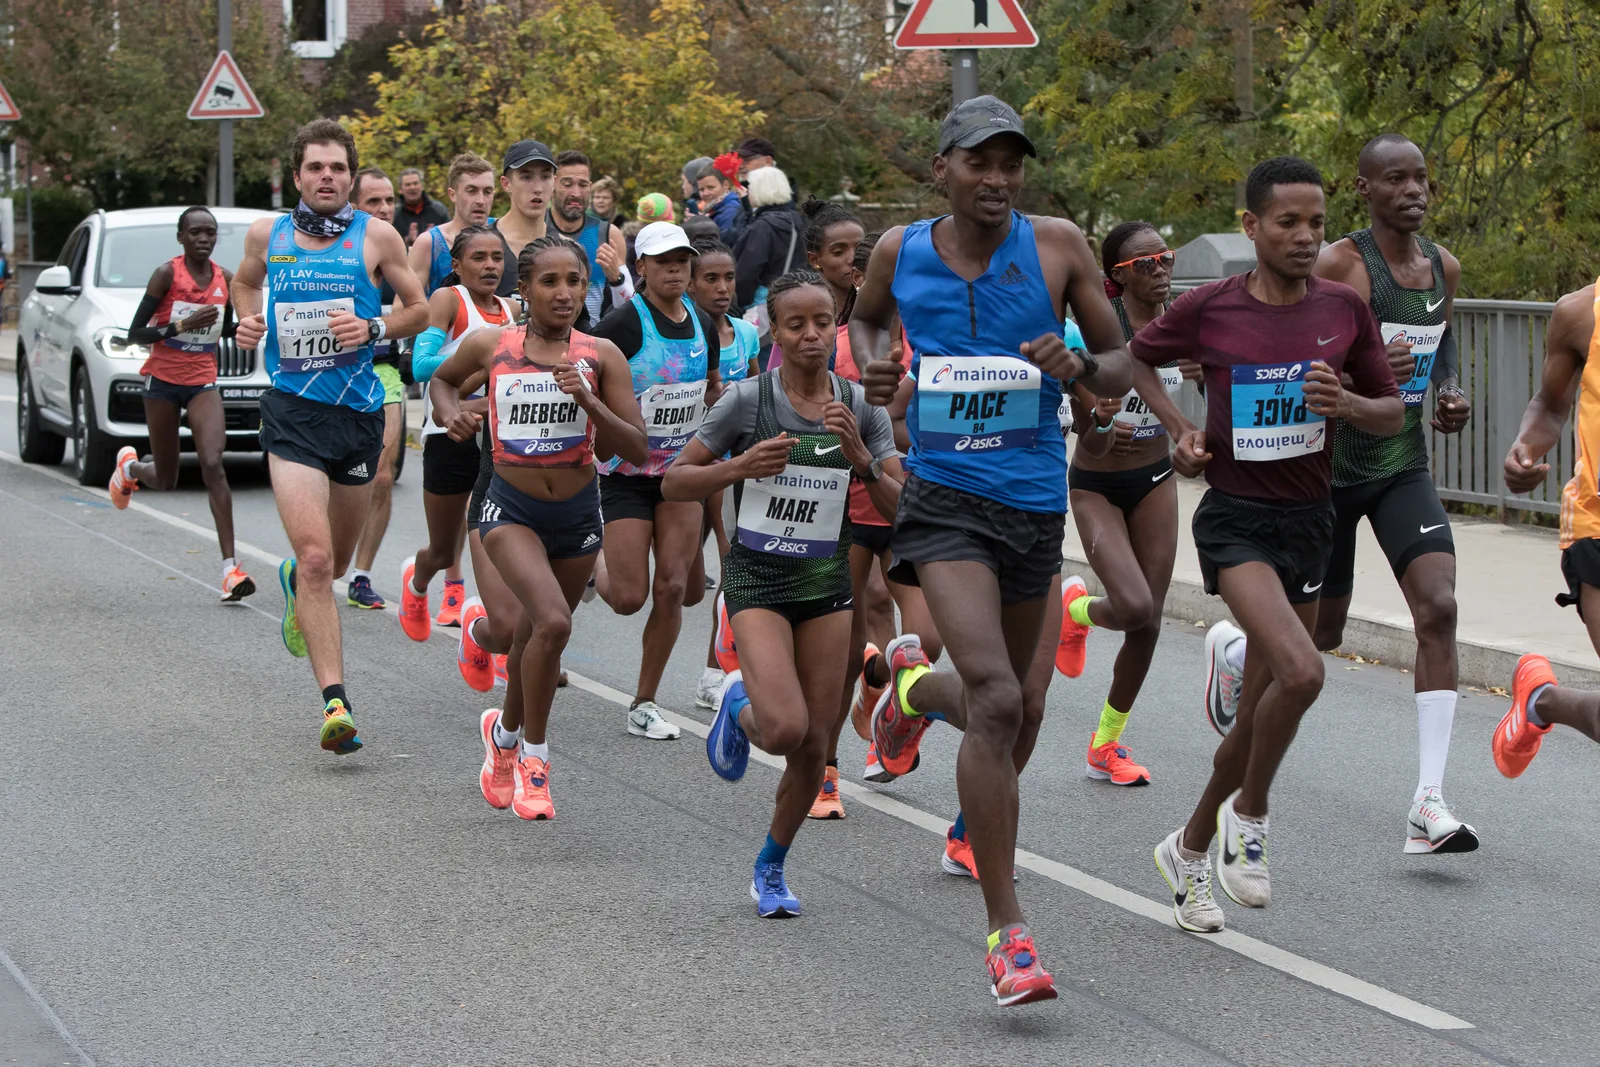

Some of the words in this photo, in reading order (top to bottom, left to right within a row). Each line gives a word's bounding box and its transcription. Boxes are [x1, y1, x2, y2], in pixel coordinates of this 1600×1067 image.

[290, 269, 313, 279] LAV
[314, 271, 355, 281] Stadtwerke
[290, 280, 355, 293] TÜBINGEN
[301, 328, 330, 337] Lorenz
[292, 336, 344, 357] 1106
[312, 359, 335, 369] asics
[954, 367, 1029, 381] mainova
[1255, 367, 1287, 380] asics
[223, 389, 242, 398] DER
[664, 387, 702, 401] mainova
[1274, 383, 1286, 396] 72
[1404, 392, 1423, 403] asics
[949, 391, 1009, 420] PACE
[1252, 395, 1307, 427] PACE
[508, 402, 579, 425] ABEBECH
[972, 422, 985, 434] 84
[1141, 417, 1149, 426] F6
[540, 428, 550, 438] F9
[672, 427, 682, 436] F14
[1136, 428, 1156, 438] asics
[537, 441, 563, 452] asics
[670, 437, 687, 447] asics
[970, 436, 1003, 450] asics
[1236, 433, 1305, 451] mainova
[774, 474, 838, 491] mainova
[765, 496, 819, 524] MARE
[783, 526, 795, 538] F2
[779, 541, 808, 554] asics
